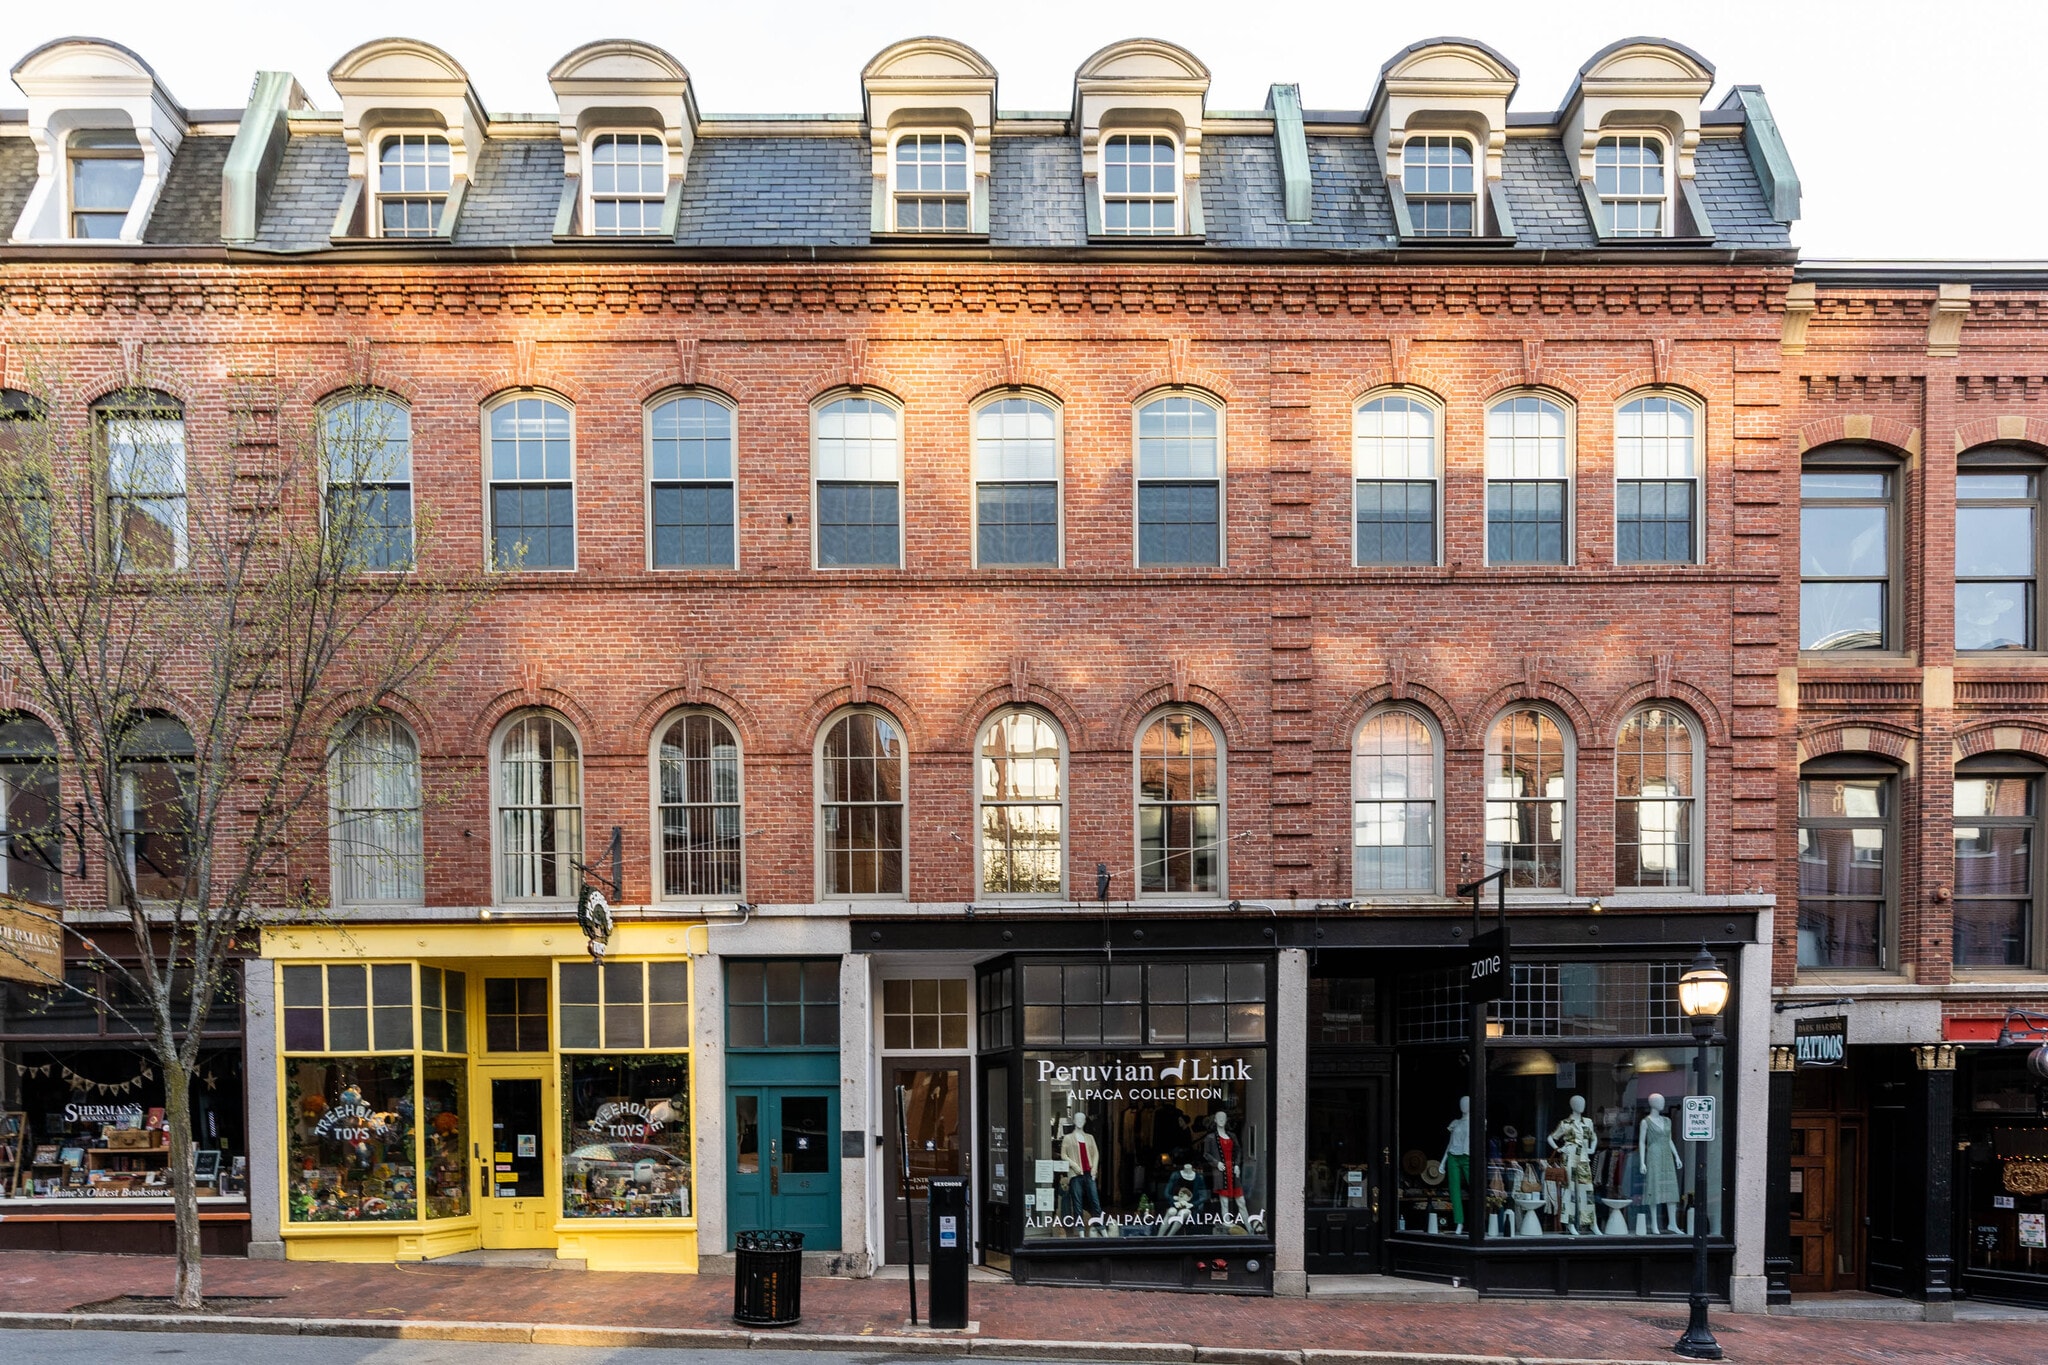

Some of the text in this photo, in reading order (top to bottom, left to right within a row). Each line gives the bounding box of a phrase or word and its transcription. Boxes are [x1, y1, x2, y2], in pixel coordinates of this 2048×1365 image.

[1471, 955, 1501, 979] zane
[1797, 1022, 1842, 1032] DARK HARBOR
[1796, 1034, 1843, 1060] TATTOOS
[1037, 1058, 1252, 1082] Peruvian Link
[1068, 1088, 1222, 1101] ALPACA COLLECTION
[65, 1102, 143, 1123] SHERMAN'S
[589, 1101, 664, 1133] TREEHOUSE
[334, 1127, 370, 1140] TOYS
[609, 1124, 644, 1137] TOYS
[87, 1188, 119, 1197] Oldest
[121, 1187, 171, 1197] Bookstore
[513, 1201, 523, 1209] 47
[1025, 1212, 1244, 1228] ALPACA ALPACA ALPACA
